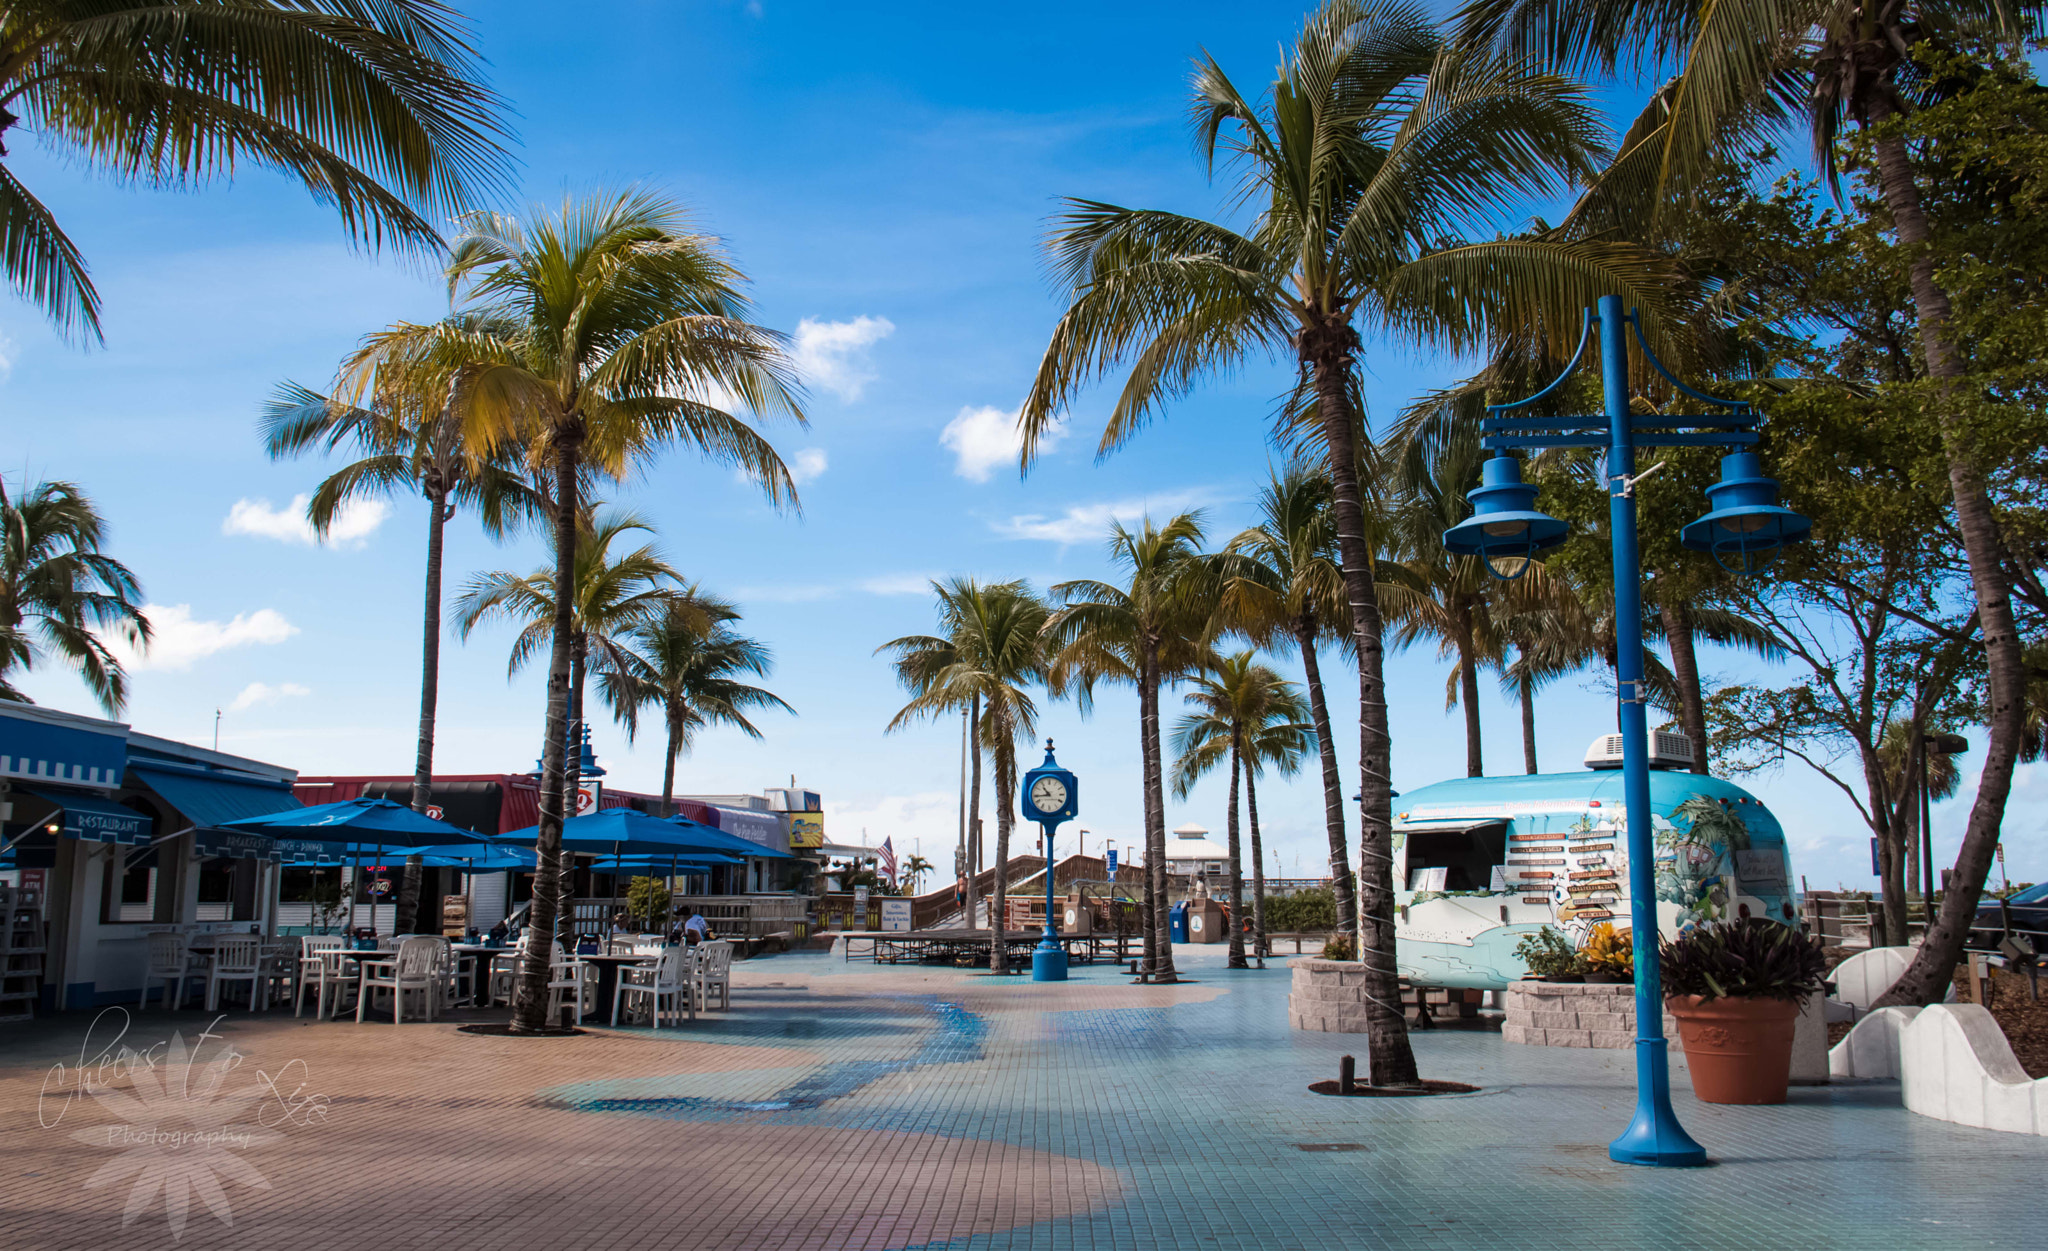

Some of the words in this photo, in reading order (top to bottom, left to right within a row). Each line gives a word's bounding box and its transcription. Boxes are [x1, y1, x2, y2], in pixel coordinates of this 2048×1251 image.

[1503, 801, 1531, 811] Visitor
[1533, 799, 1587, 810] Information
[78, 815, 140, 833] RESTAURANT
[226, 835, 267, 849] BREAKFAST
[272, 838, 295, 851] LUNCH
[300, 841, 324, 853] DINNER
[24, 881, 41, 889] ATM
